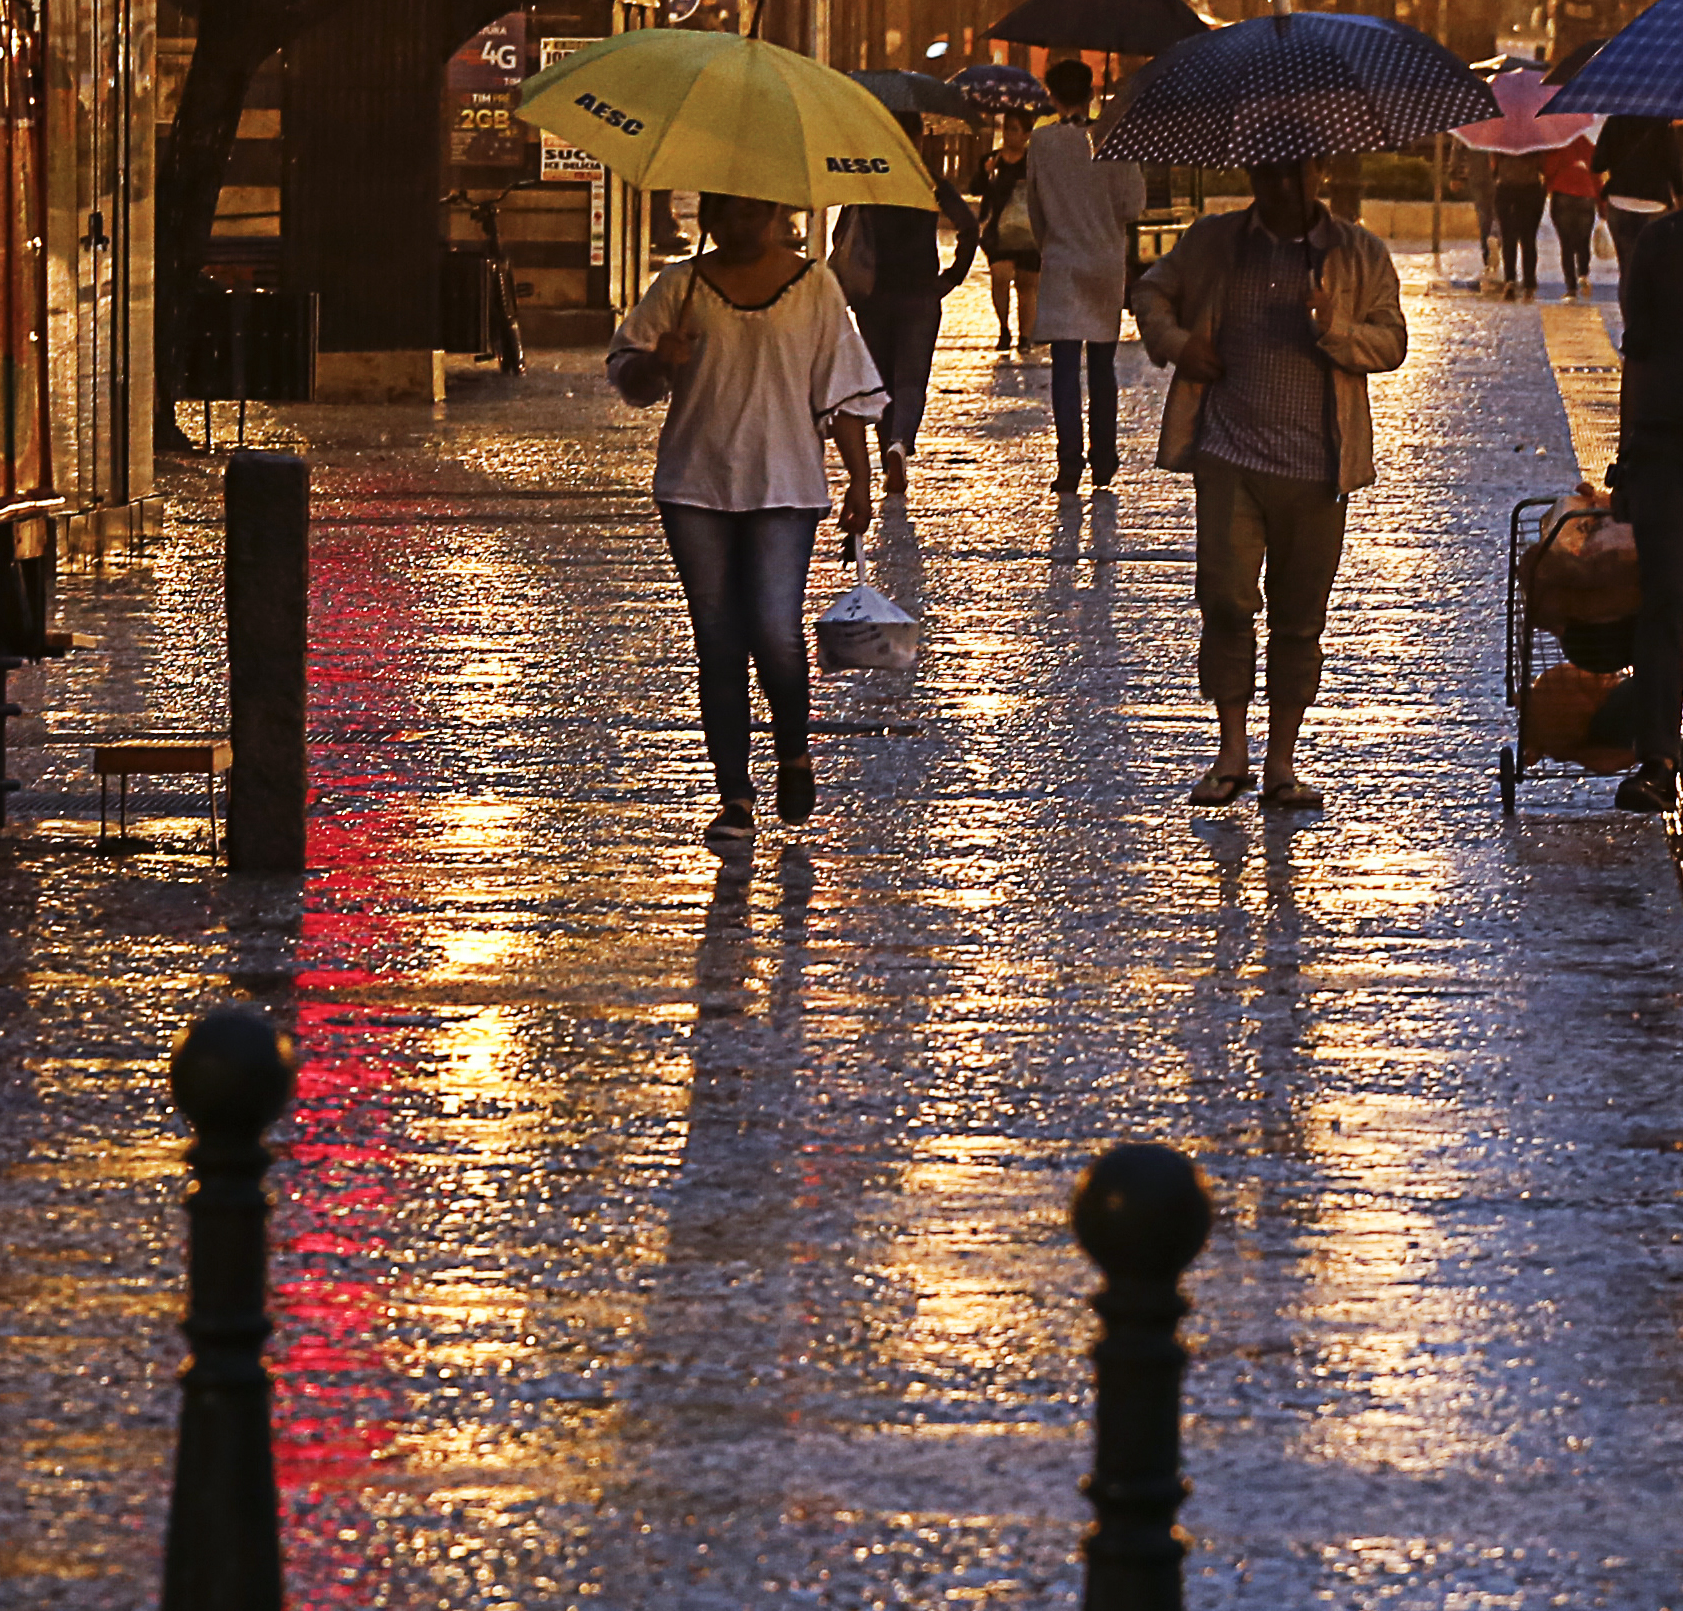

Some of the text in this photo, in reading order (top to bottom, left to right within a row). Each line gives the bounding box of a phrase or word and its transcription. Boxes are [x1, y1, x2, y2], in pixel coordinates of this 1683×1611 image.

[481, 41, 517, 70] 4G
[472, 93, 491, 104] TIM
[461, 109, 510, 130] 2GB
[573, 92, 645, 136] AESC
[825, 156, 891, 174] AESC
